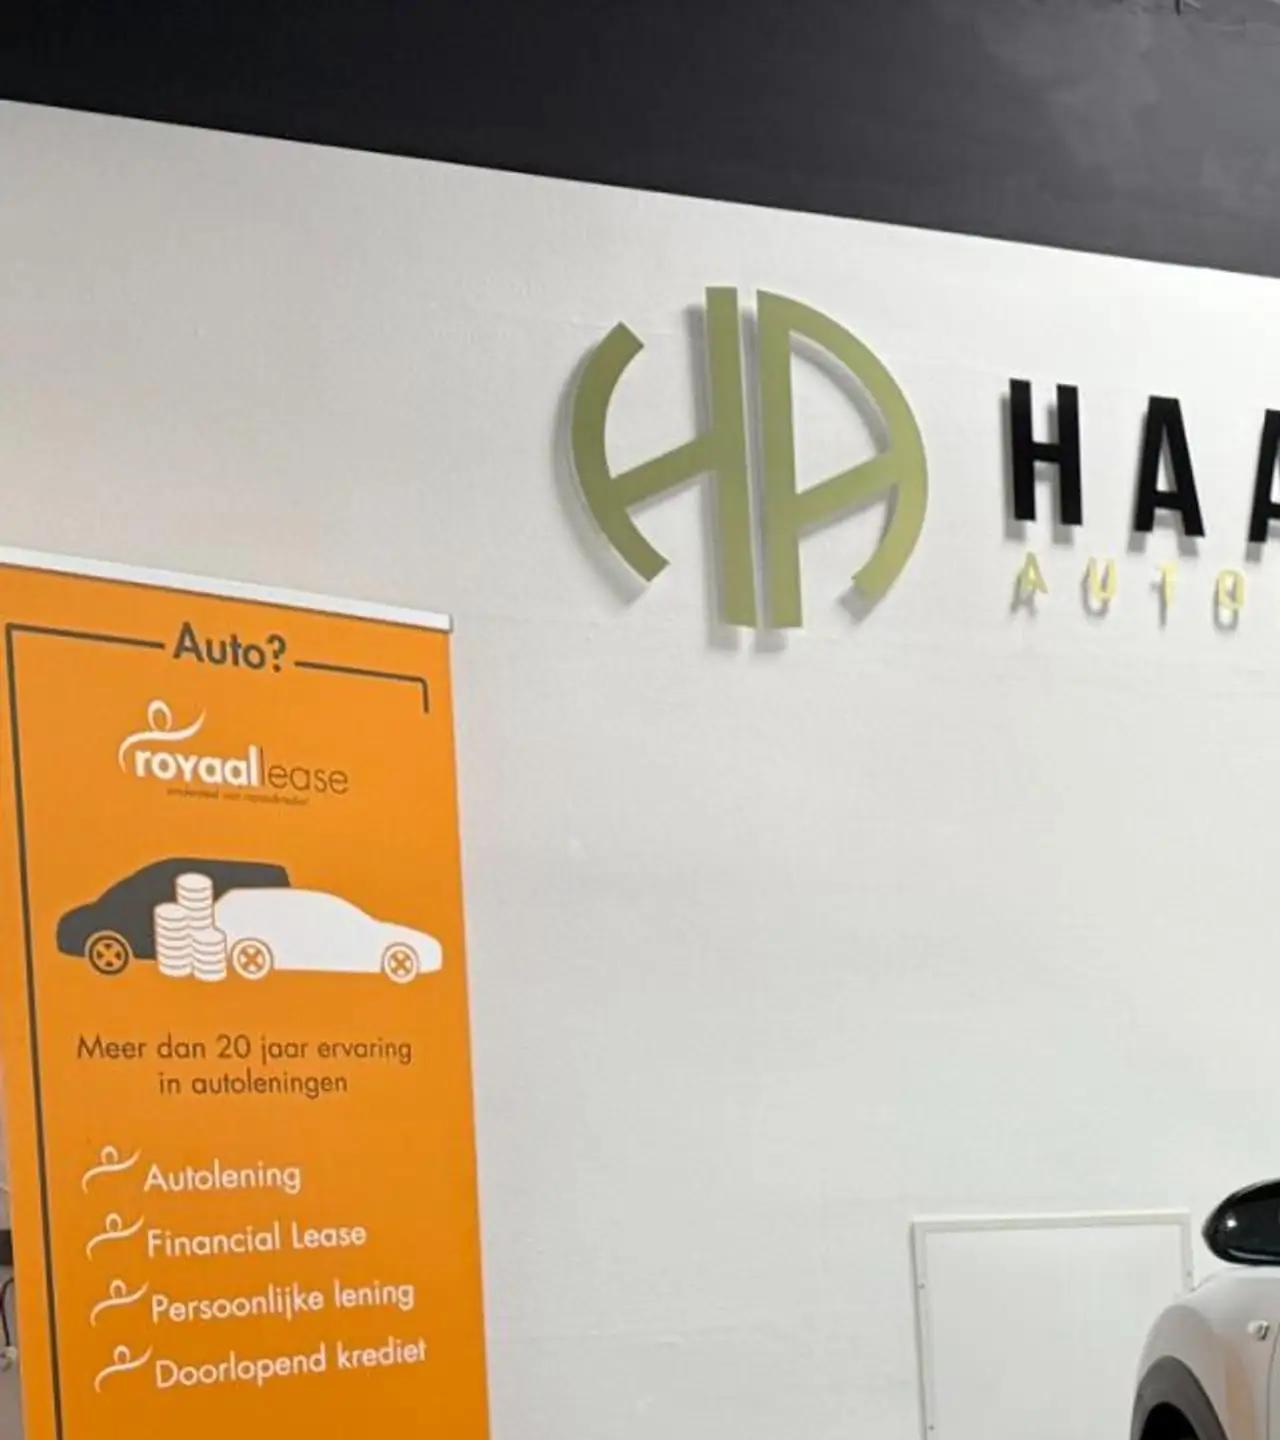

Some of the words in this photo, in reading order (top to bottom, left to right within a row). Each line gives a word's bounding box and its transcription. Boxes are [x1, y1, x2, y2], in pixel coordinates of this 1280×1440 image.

[172, 621, 288, 673] Auto?
[76, 1035, 147, 1061] Meer
[157, 1034, 206, 1060] dan
[216, 1034, 251, 1060] 20
[260, 1035, 308, 1065] jaar
[317, 1036, 413, 1065] ervaring
[158, 1072, 181, 1096] in
[191, 1069, 348, 1100] autoleningen
[143, 1159, 302, 1194] Autolening
[147, 1221, 281, 1259] Financial
[292, 1221, 368, 1250] Lease
[151, 1282, 324, 1325] Persoonlijke
[334, 1279, 415, 1313] lening
[155, 1343, 327, 1389] Doorlopend
[337, 1337, 428, 1370] krediet
